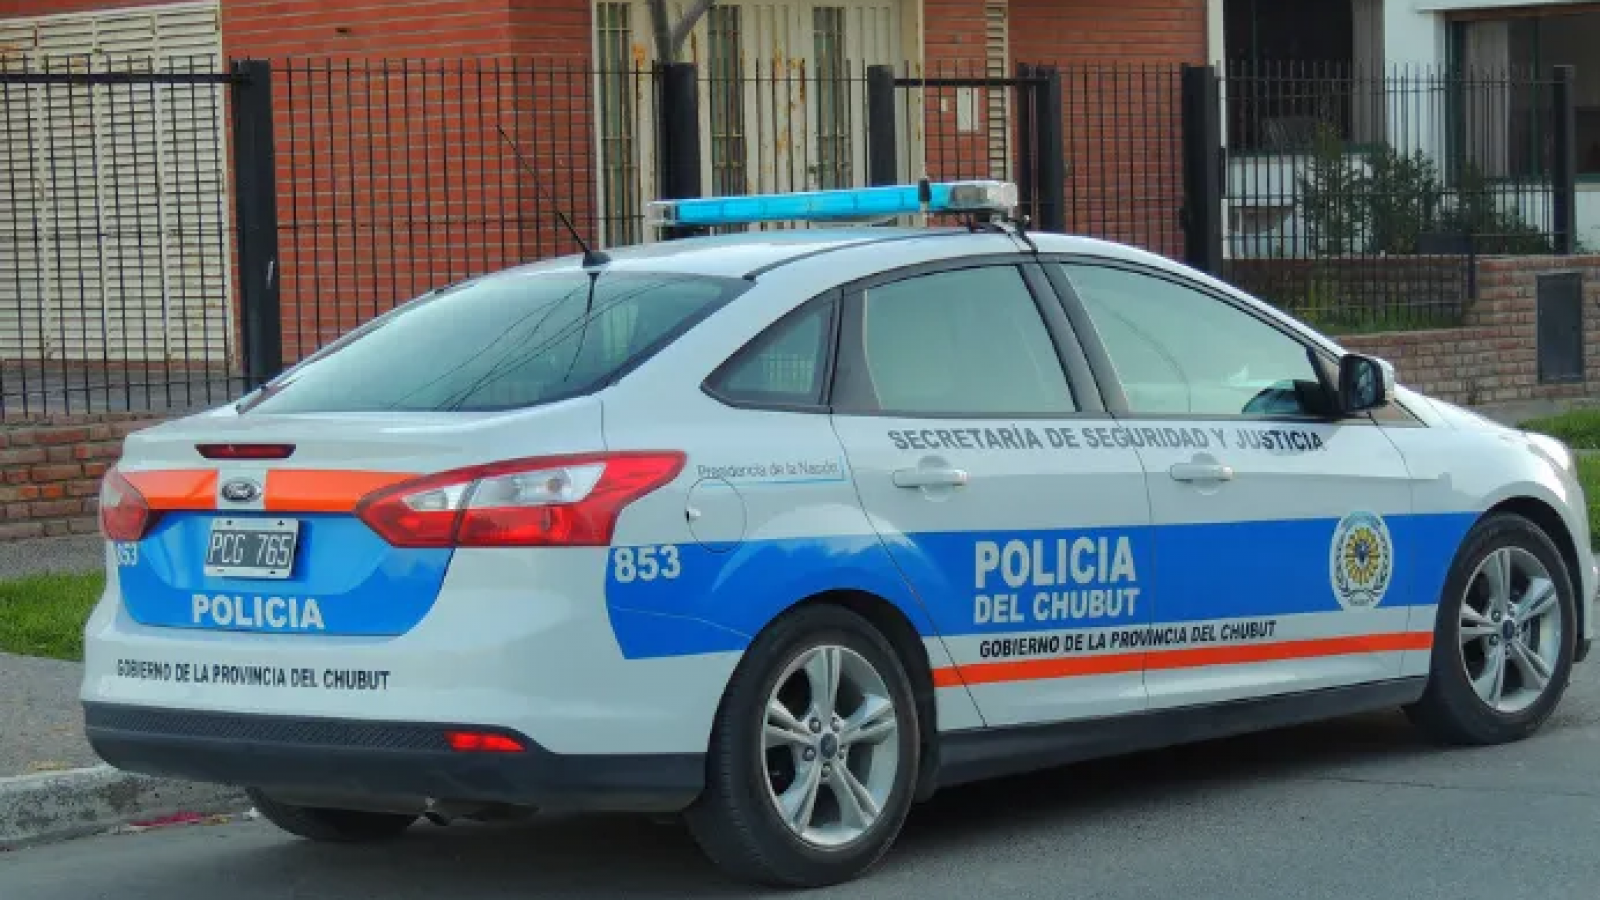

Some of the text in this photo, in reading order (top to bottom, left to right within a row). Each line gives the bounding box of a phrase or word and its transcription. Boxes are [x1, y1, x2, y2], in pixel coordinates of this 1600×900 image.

[1045, 427, 1081, 449] DE
[1081, 427, 1210, 449] SEGURIDAD
[1210, 427, 1228, 448] Y
[1236, 429, 1325, 451] JUSTICIA
[208, 532, 292, 566] PCG 765
[614, 545, 681, 584] 853
[974, 535, 1137, 589] POLICIA
[191, 594, 325, 630] POLICIA
[974, 588, 1140, 625] DEL CHUBUT
[979, 619, 1277, 659] GOBIERNO DE LA PROVINCIA DEL CHUBUT
[117, 658, 391, 690] GOBIERNO DE LA PROVINCIA DEL CHUBUT
